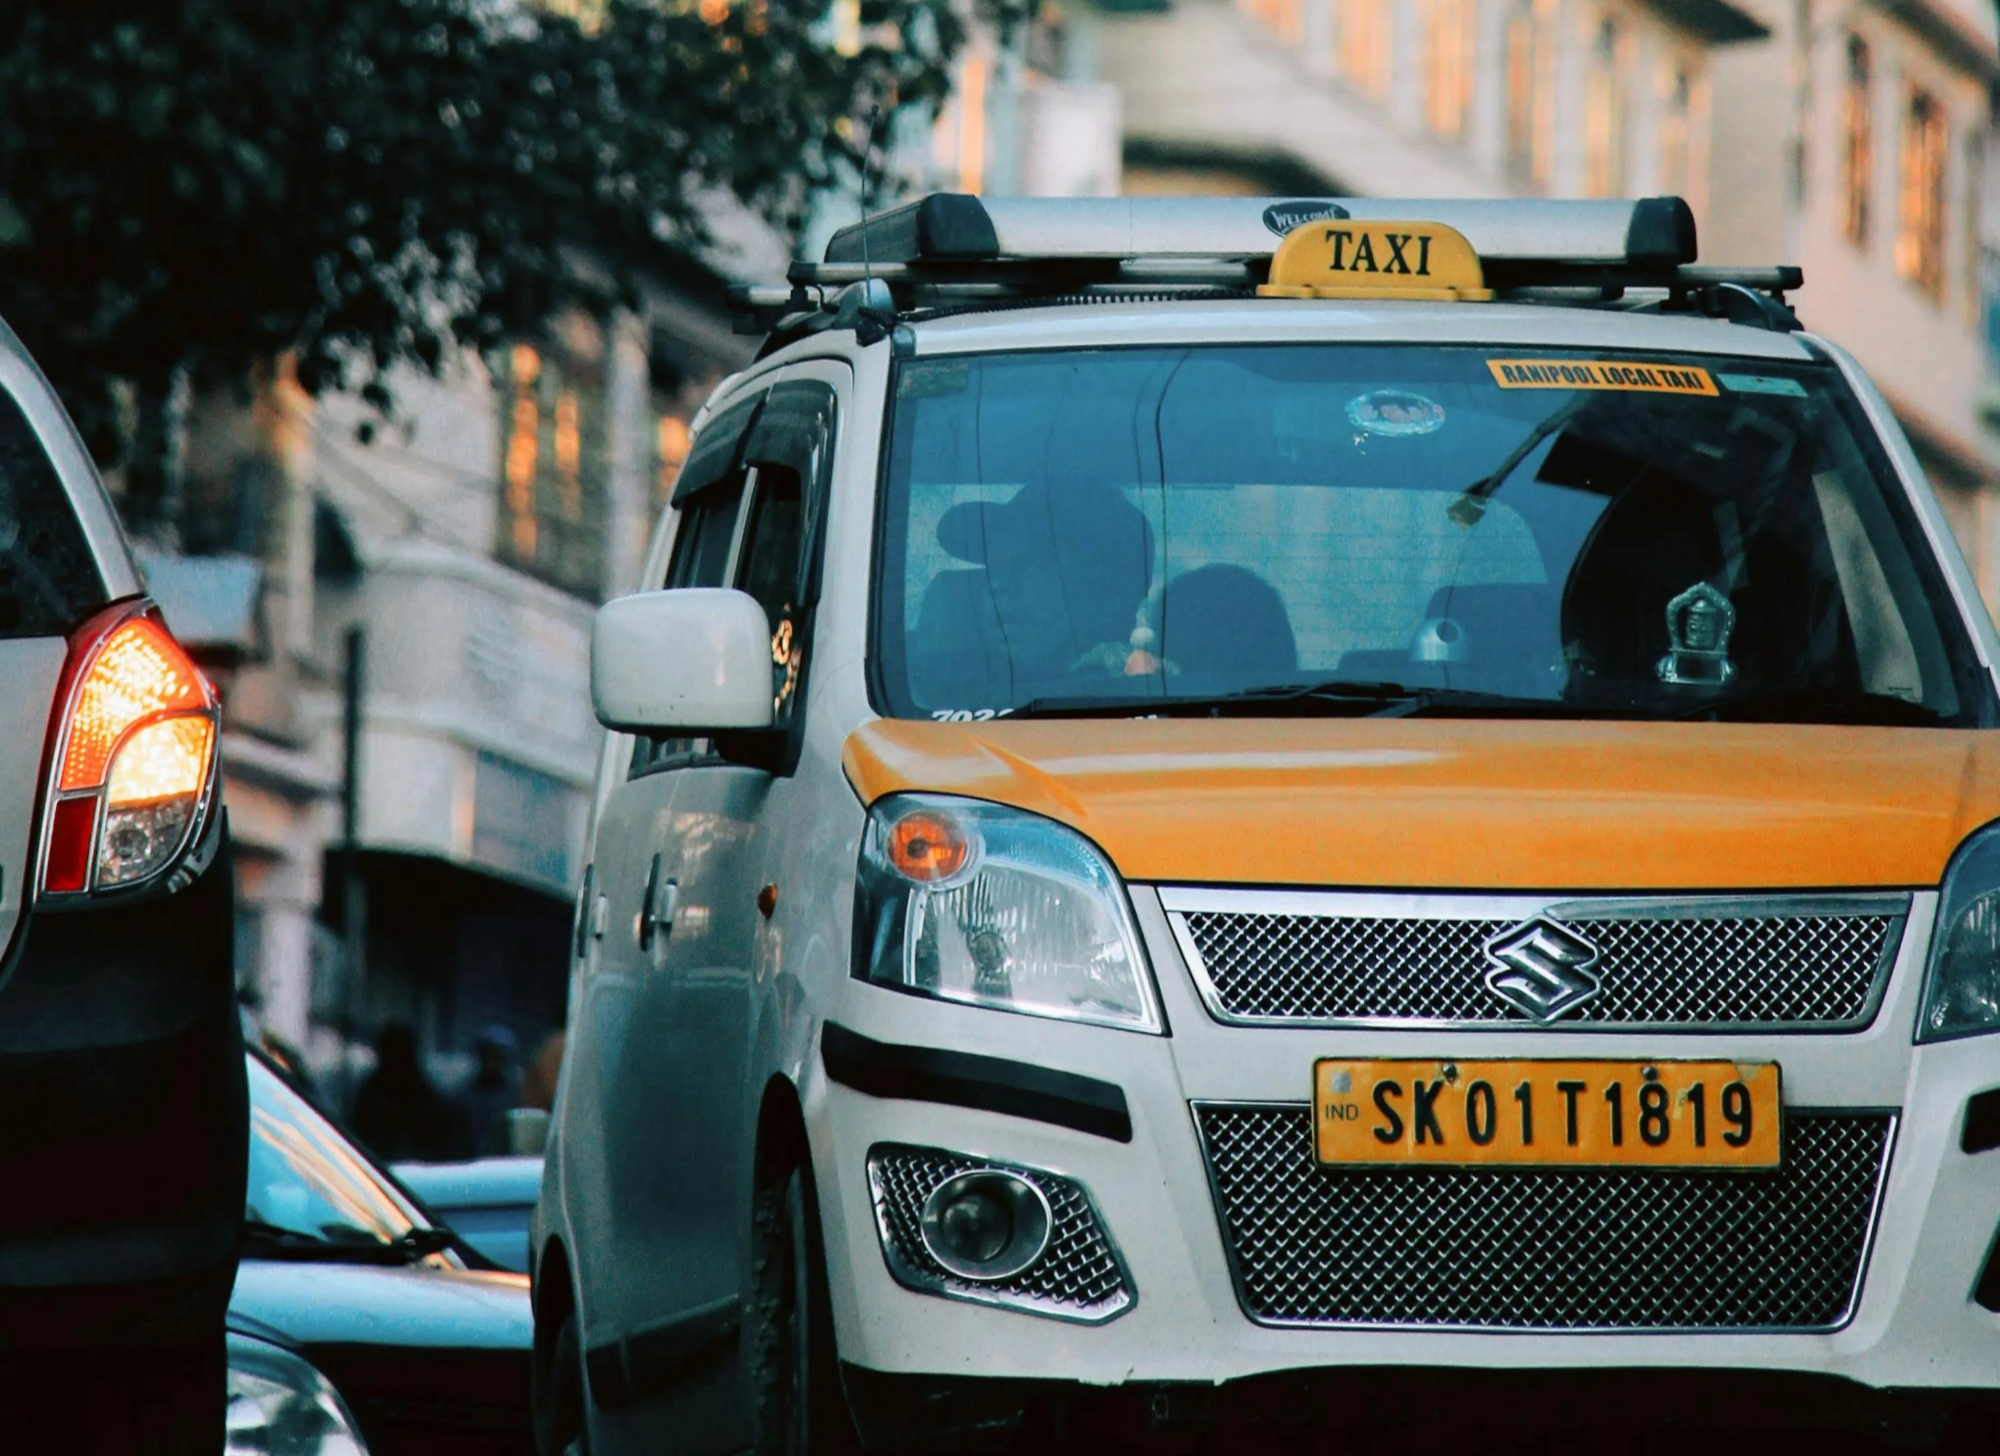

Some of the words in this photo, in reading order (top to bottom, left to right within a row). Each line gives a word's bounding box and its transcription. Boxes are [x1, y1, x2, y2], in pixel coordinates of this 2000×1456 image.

[1325, 230, 1432, 276] TAXI
[1501, 365, 1599, 384] RANIPOOL
[1600, 366, 1661, 387] LOCAL
[1659, 369, 1705, 390] TAXI
[1325, 1103, 1359, 1121] IND
